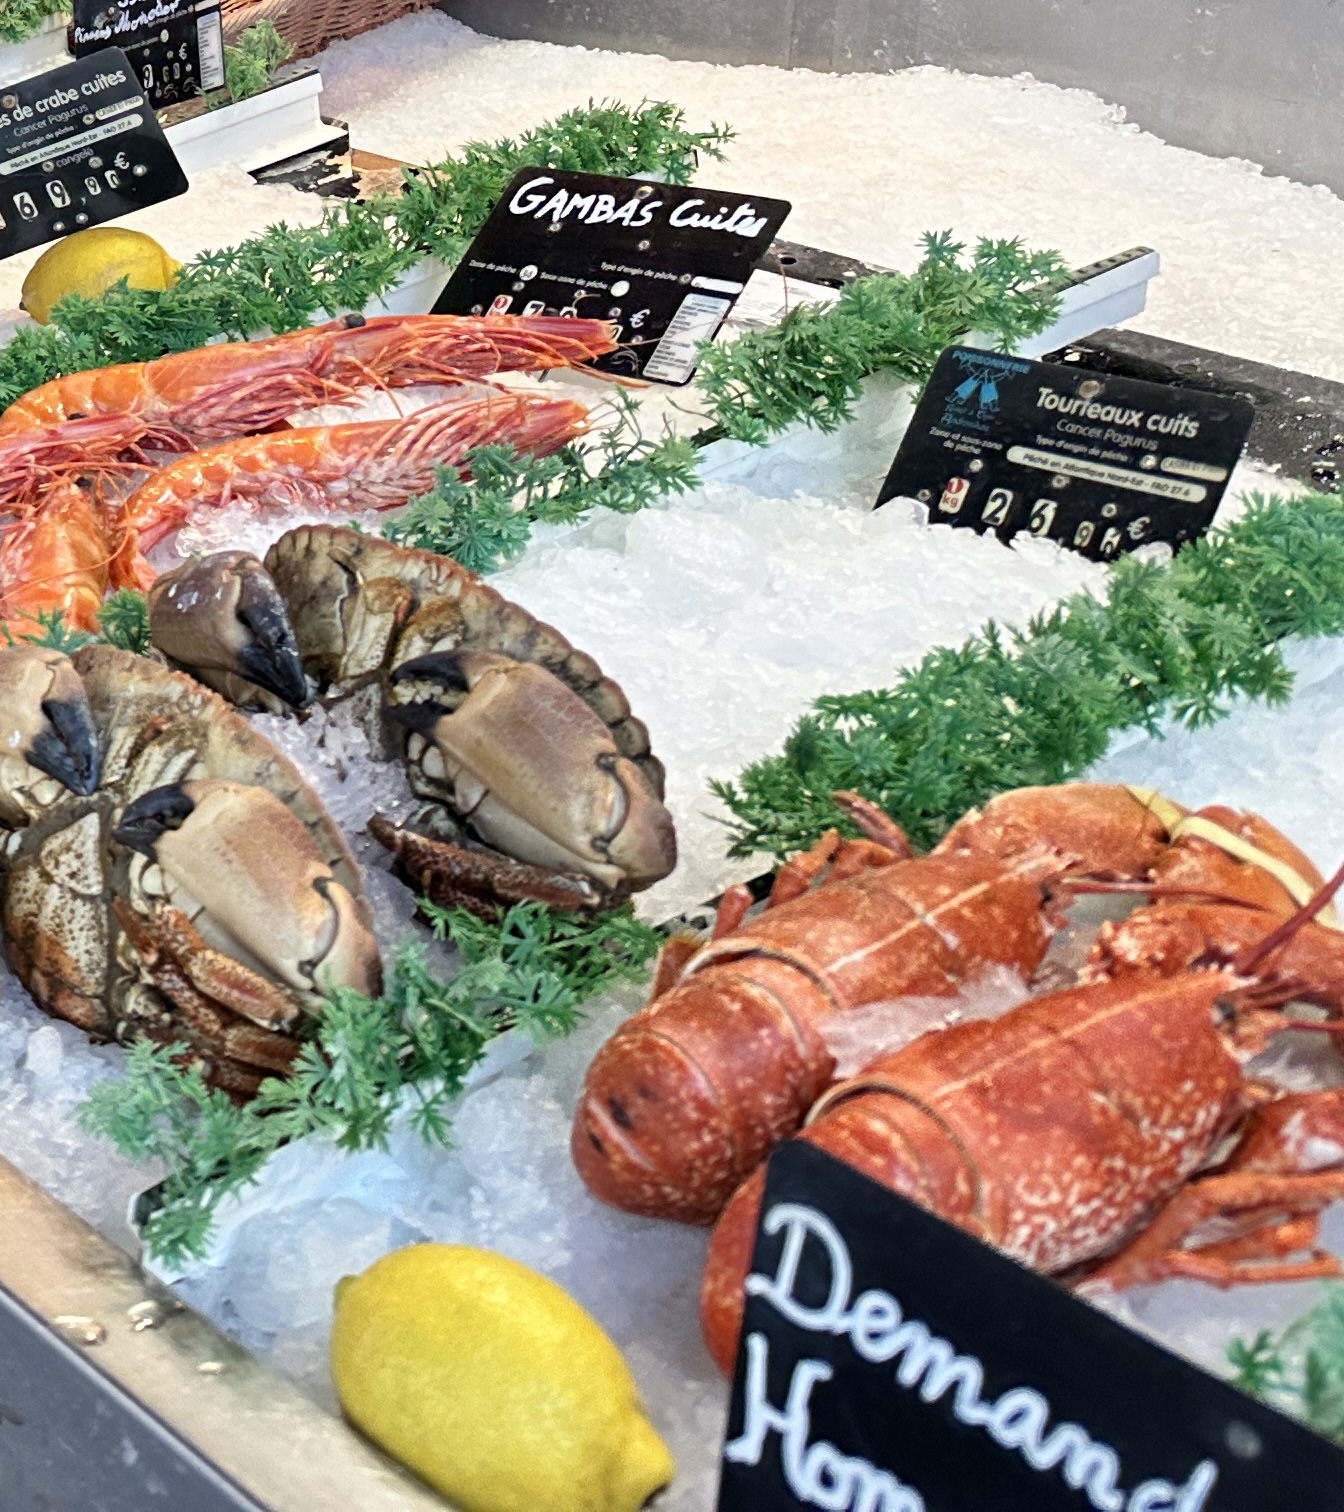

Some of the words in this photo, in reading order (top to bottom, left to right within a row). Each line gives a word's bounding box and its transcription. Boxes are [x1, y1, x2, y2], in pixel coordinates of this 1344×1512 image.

[12, 102, 33, 122] de
[35, 85, 80, 115] crabe
[81, 69, 127, 96] cuites
[13, 120, 48, 137] Cancer
[48, 104, 89, 125] Pagurus
[56, 147, 94, 168] congelé
[113, 151, 130, 170] €
[509, 176, 664, 228] GAMBAS
[629, 308, 651, 329] €
[1036, 386, 1145, 428] Tourteaux
[1146, 413, 1200, 440] cuits
[1056, 418, 1103, 440] Cancer
[1103, 428, 1159, 452] Pagurus
[1126, 515, 1151, 540] €
